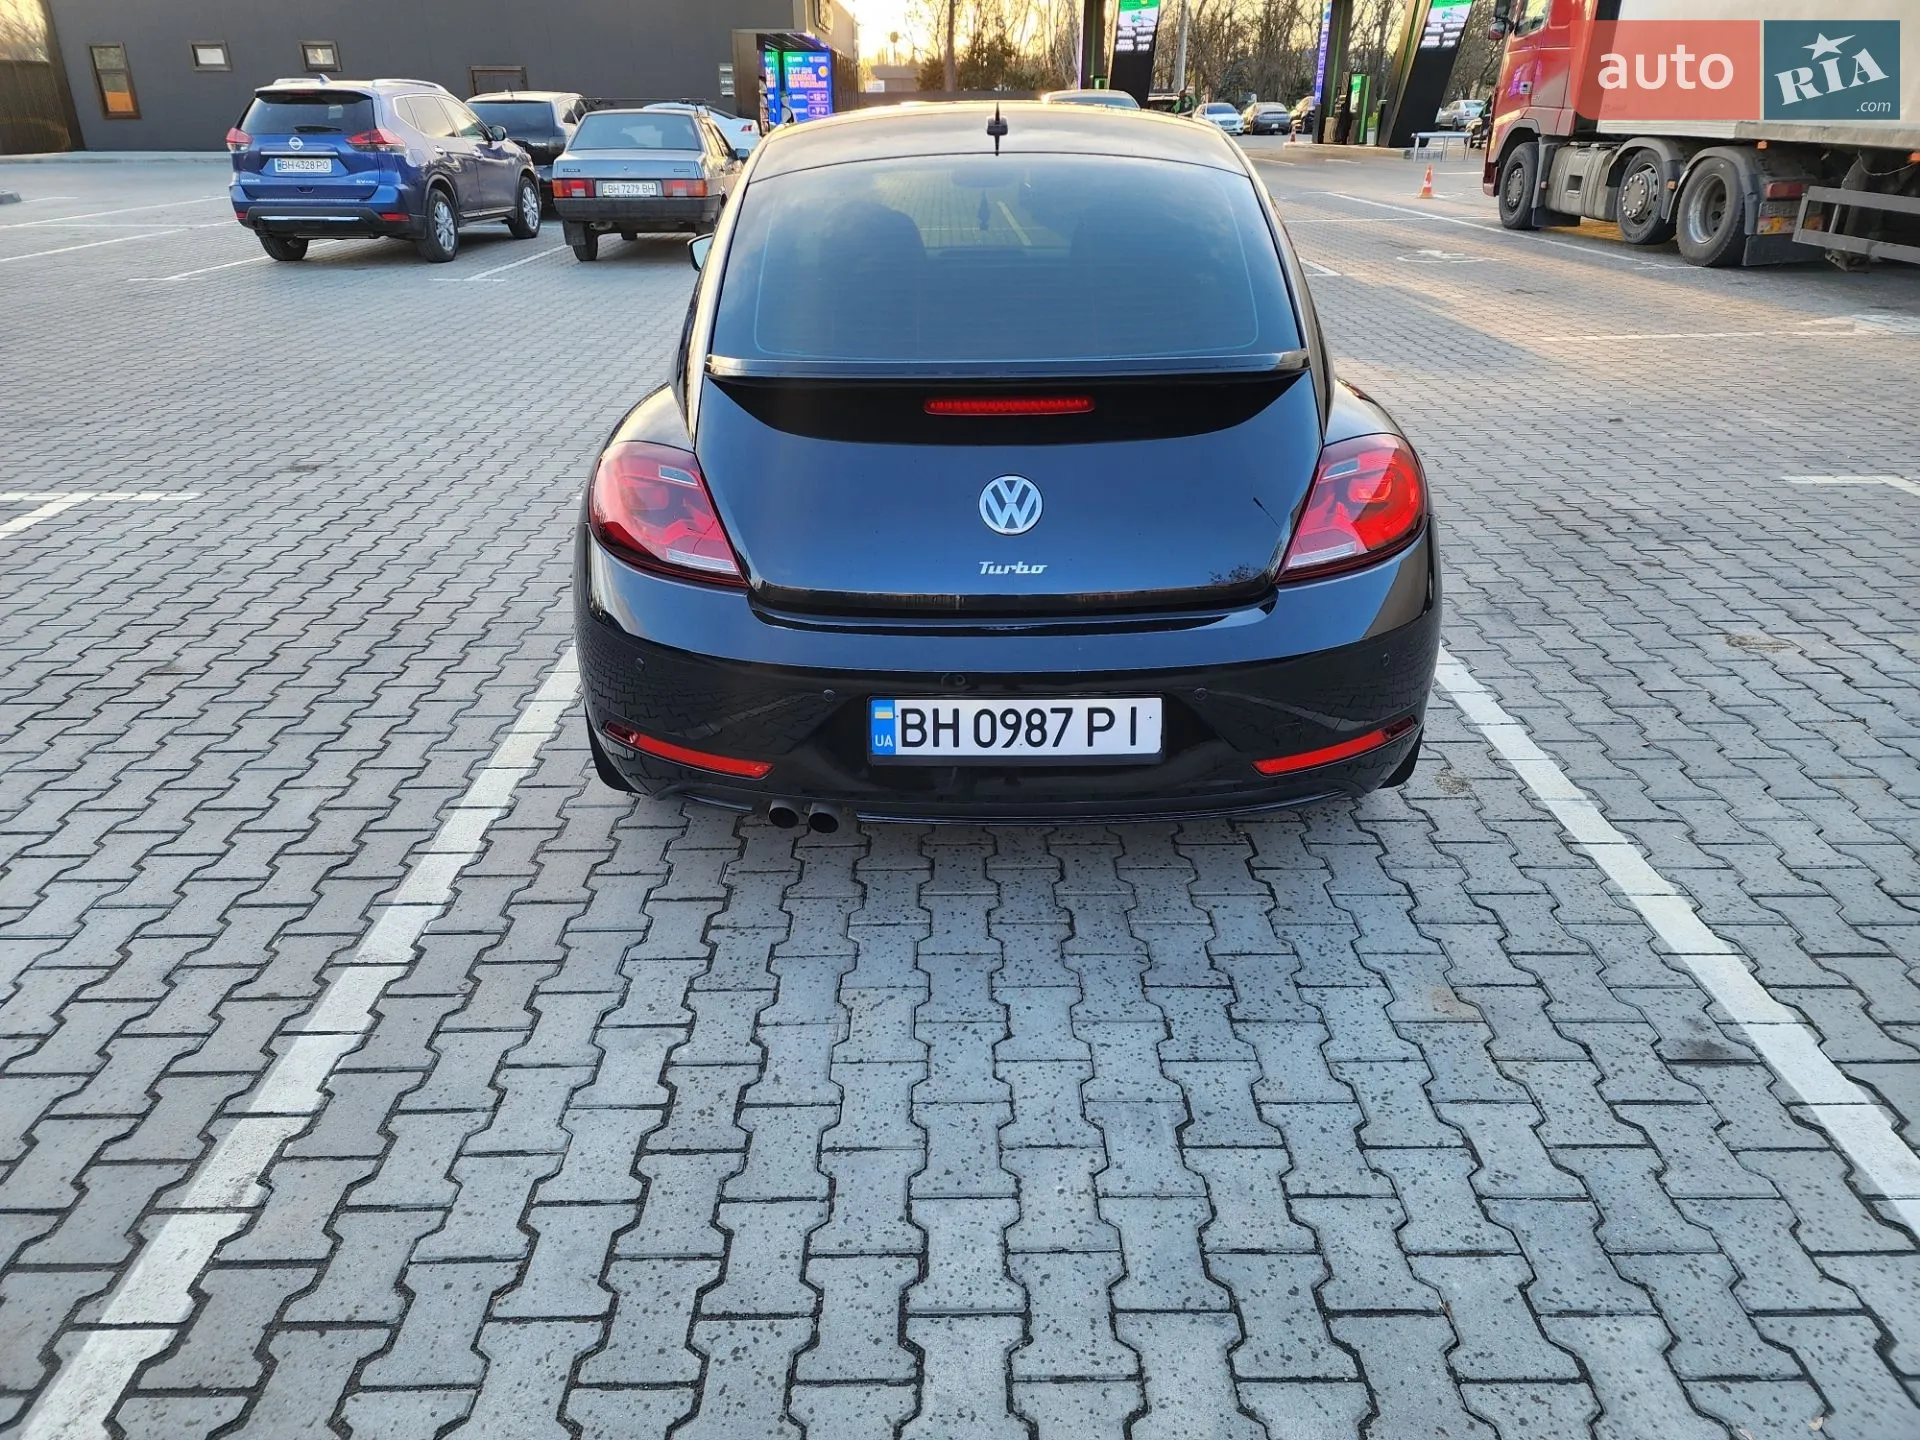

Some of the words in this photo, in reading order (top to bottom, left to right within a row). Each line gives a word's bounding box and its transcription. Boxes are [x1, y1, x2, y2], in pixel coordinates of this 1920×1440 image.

[281, 160, 295, 170] BH
[295, 160, 315, 170] 4328
[608, 183, 620, 194] BH
[979, 561, 1048, 575] Turbo
[900, 707, 960, 748] BH
[973, 707, 1074, 749] 0987
[875, 734, 894, 748] UA
